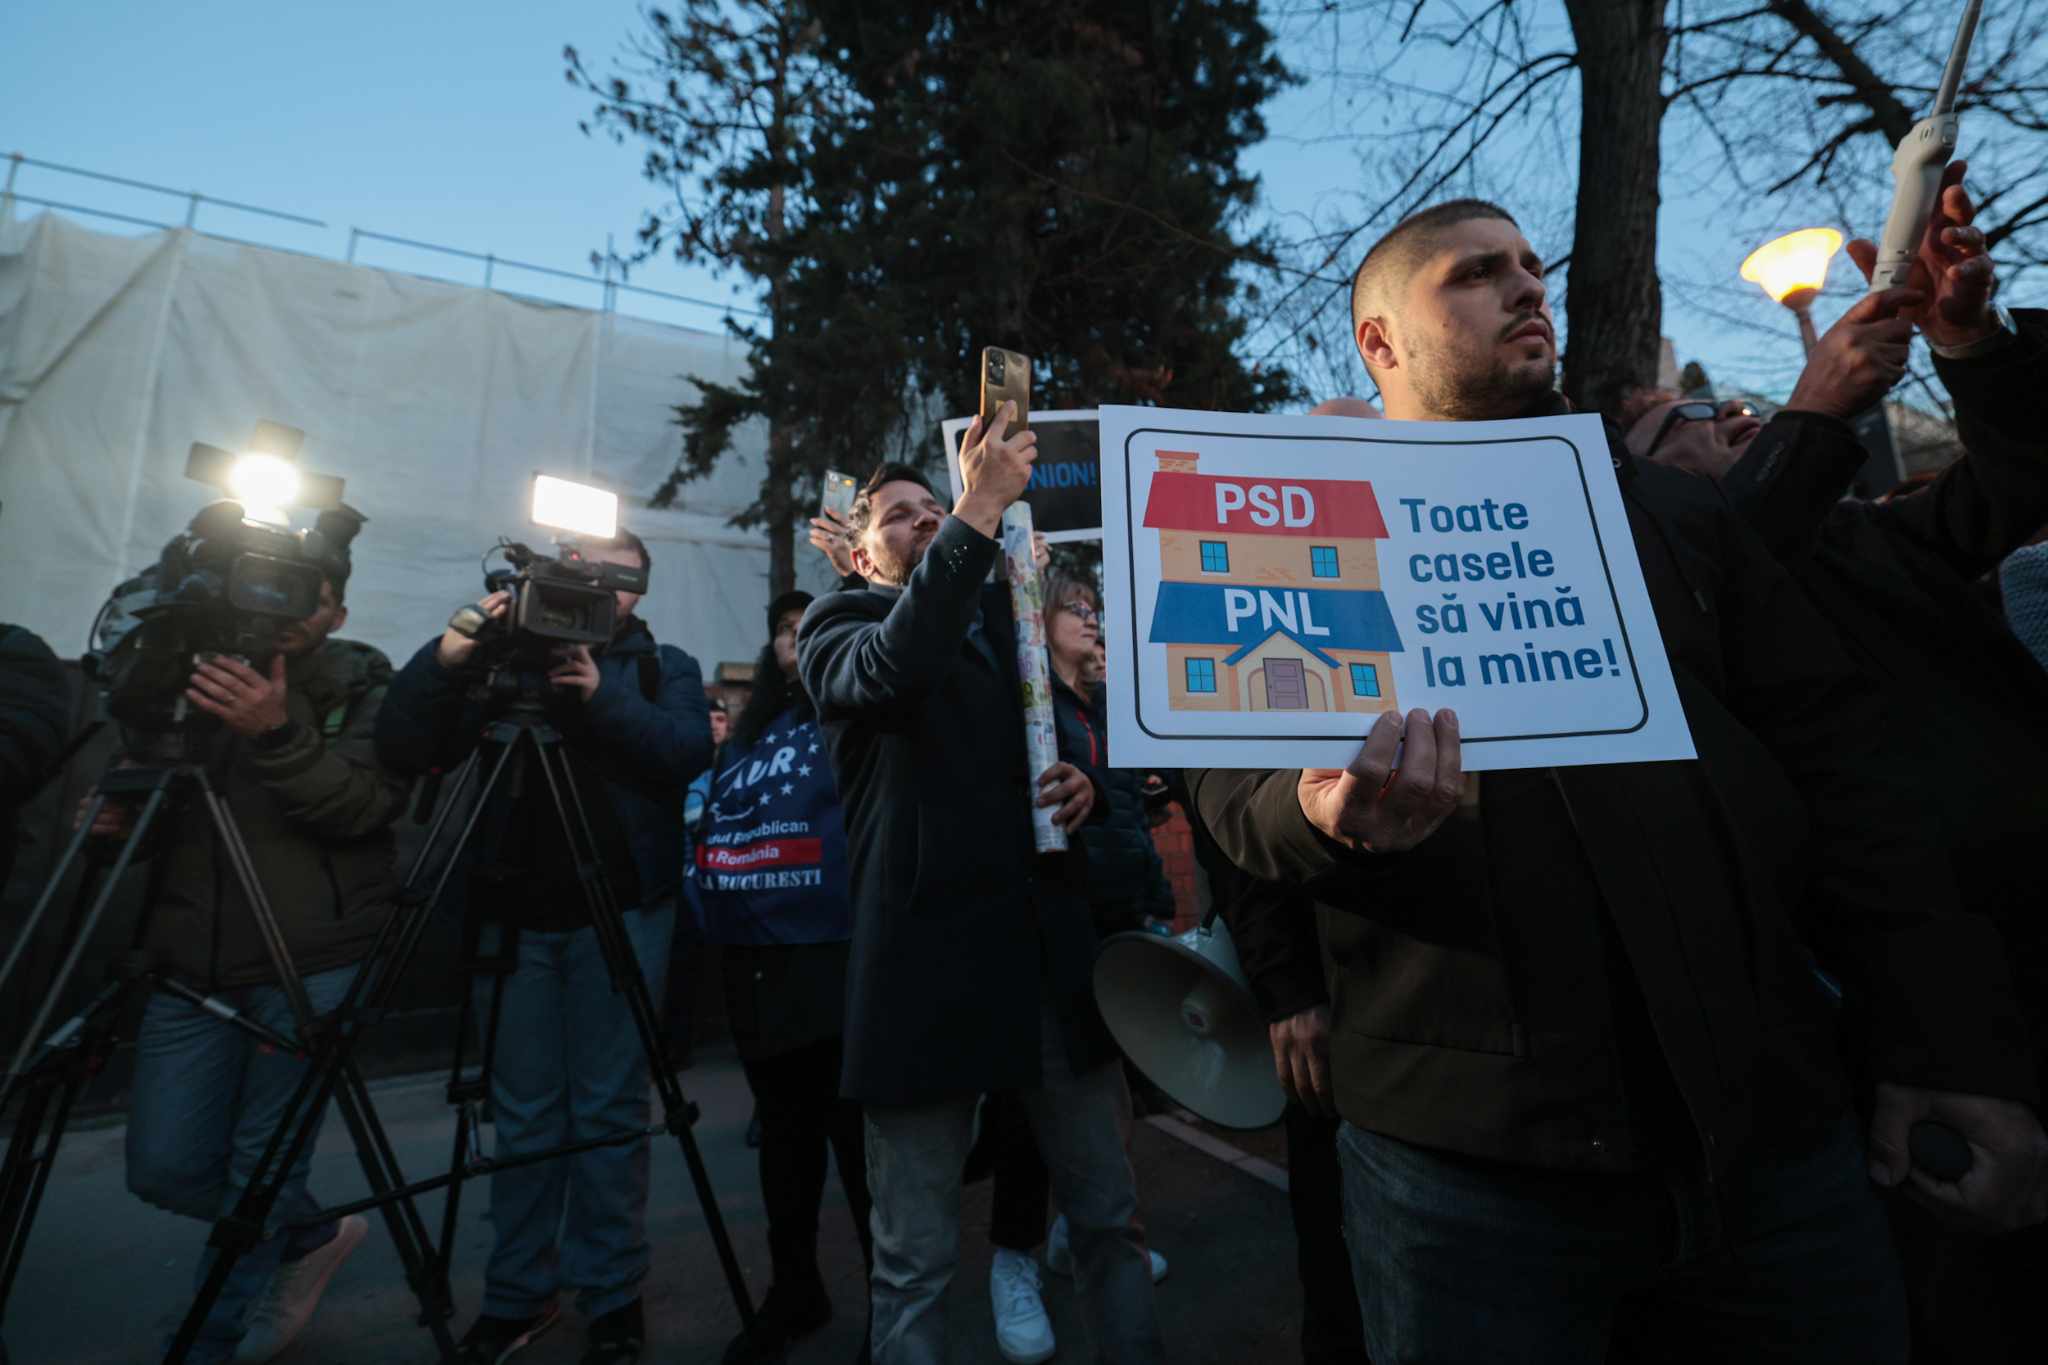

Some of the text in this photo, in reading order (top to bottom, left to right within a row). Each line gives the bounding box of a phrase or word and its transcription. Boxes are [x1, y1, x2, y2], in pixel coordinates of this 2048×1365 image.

[1215, 483, 1315, 528] PSD
[1400, 498, 1529, 533] Toate
[1409, 541, 1555, 582] casele
[1224, 588, 1330, 636] PNL
[1415, 586, 1585, 634] să vină
[1422, 638, 1621, 687] la mine!
